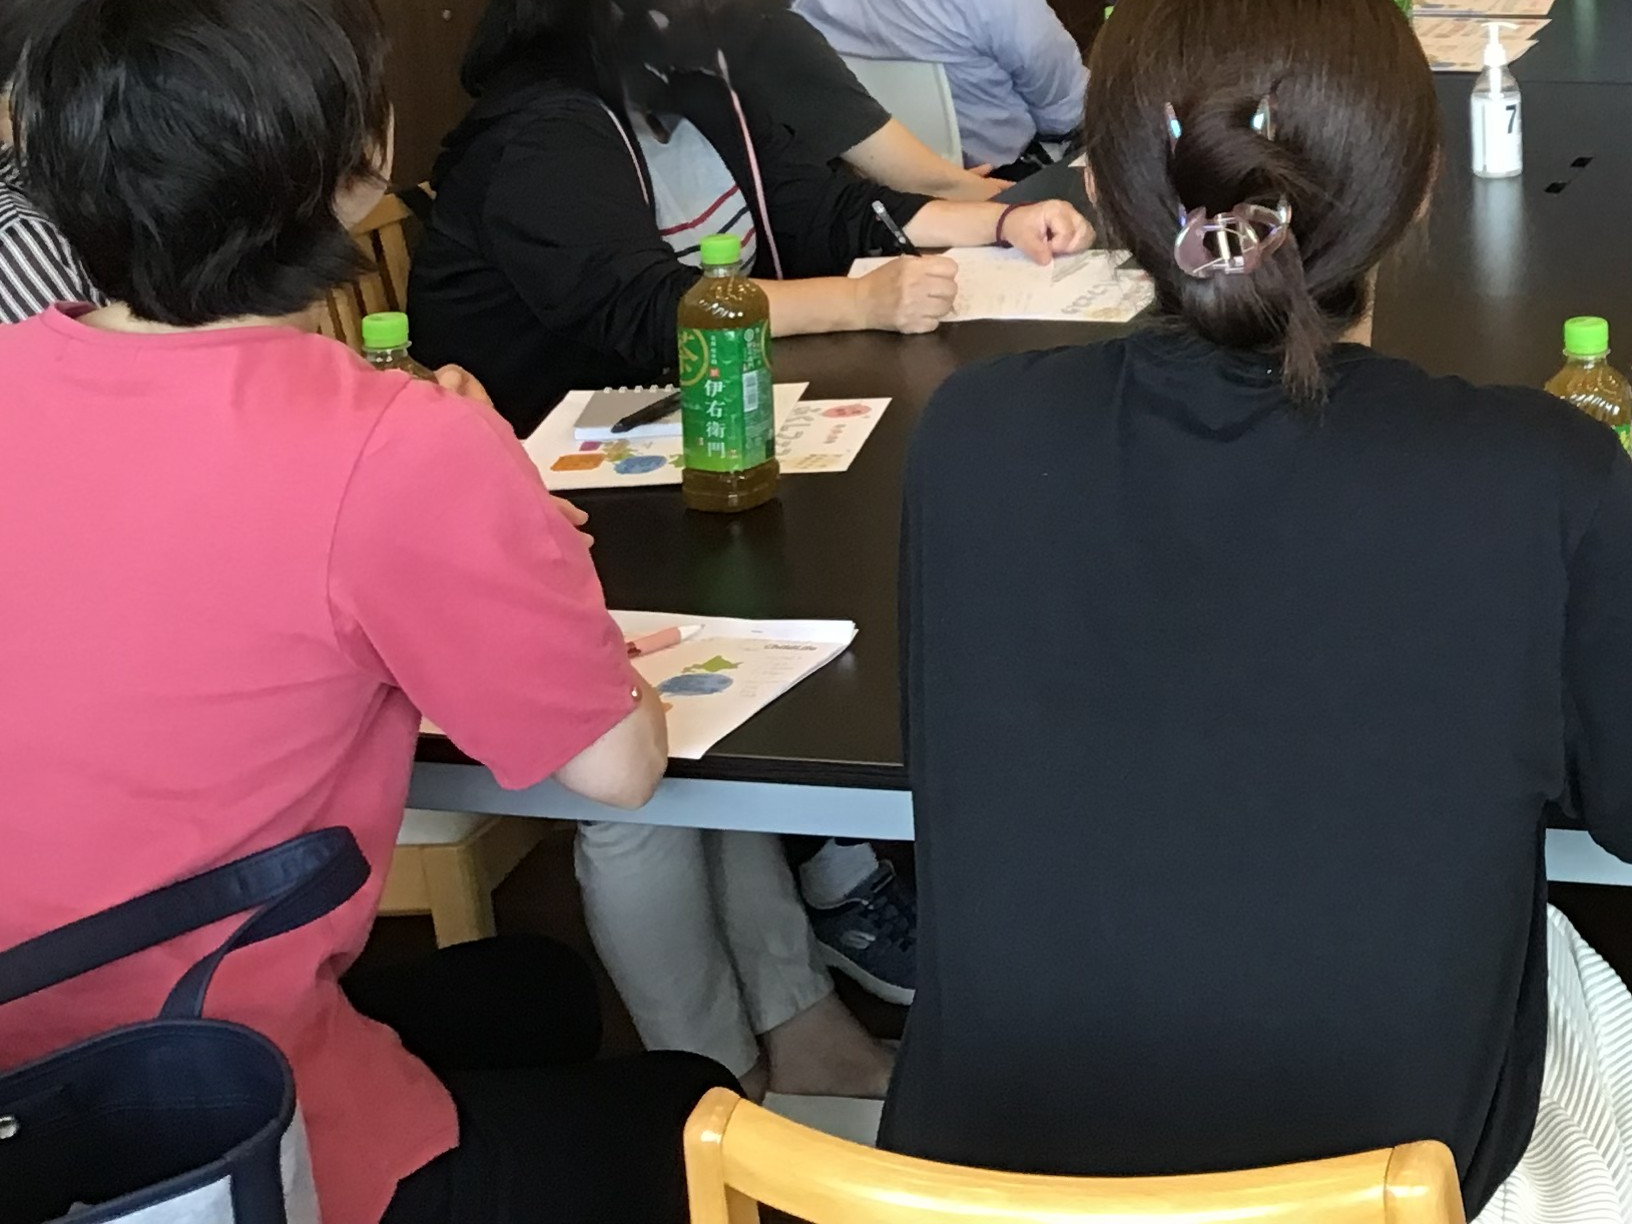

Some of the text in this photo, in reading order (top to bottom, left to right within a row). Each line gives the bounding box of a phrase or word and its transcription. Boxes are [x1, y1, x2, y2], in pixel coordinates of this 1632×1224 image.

[1505, 104, 1517, 134] 7
[704, 379, 726, 459] 伊右衛門
